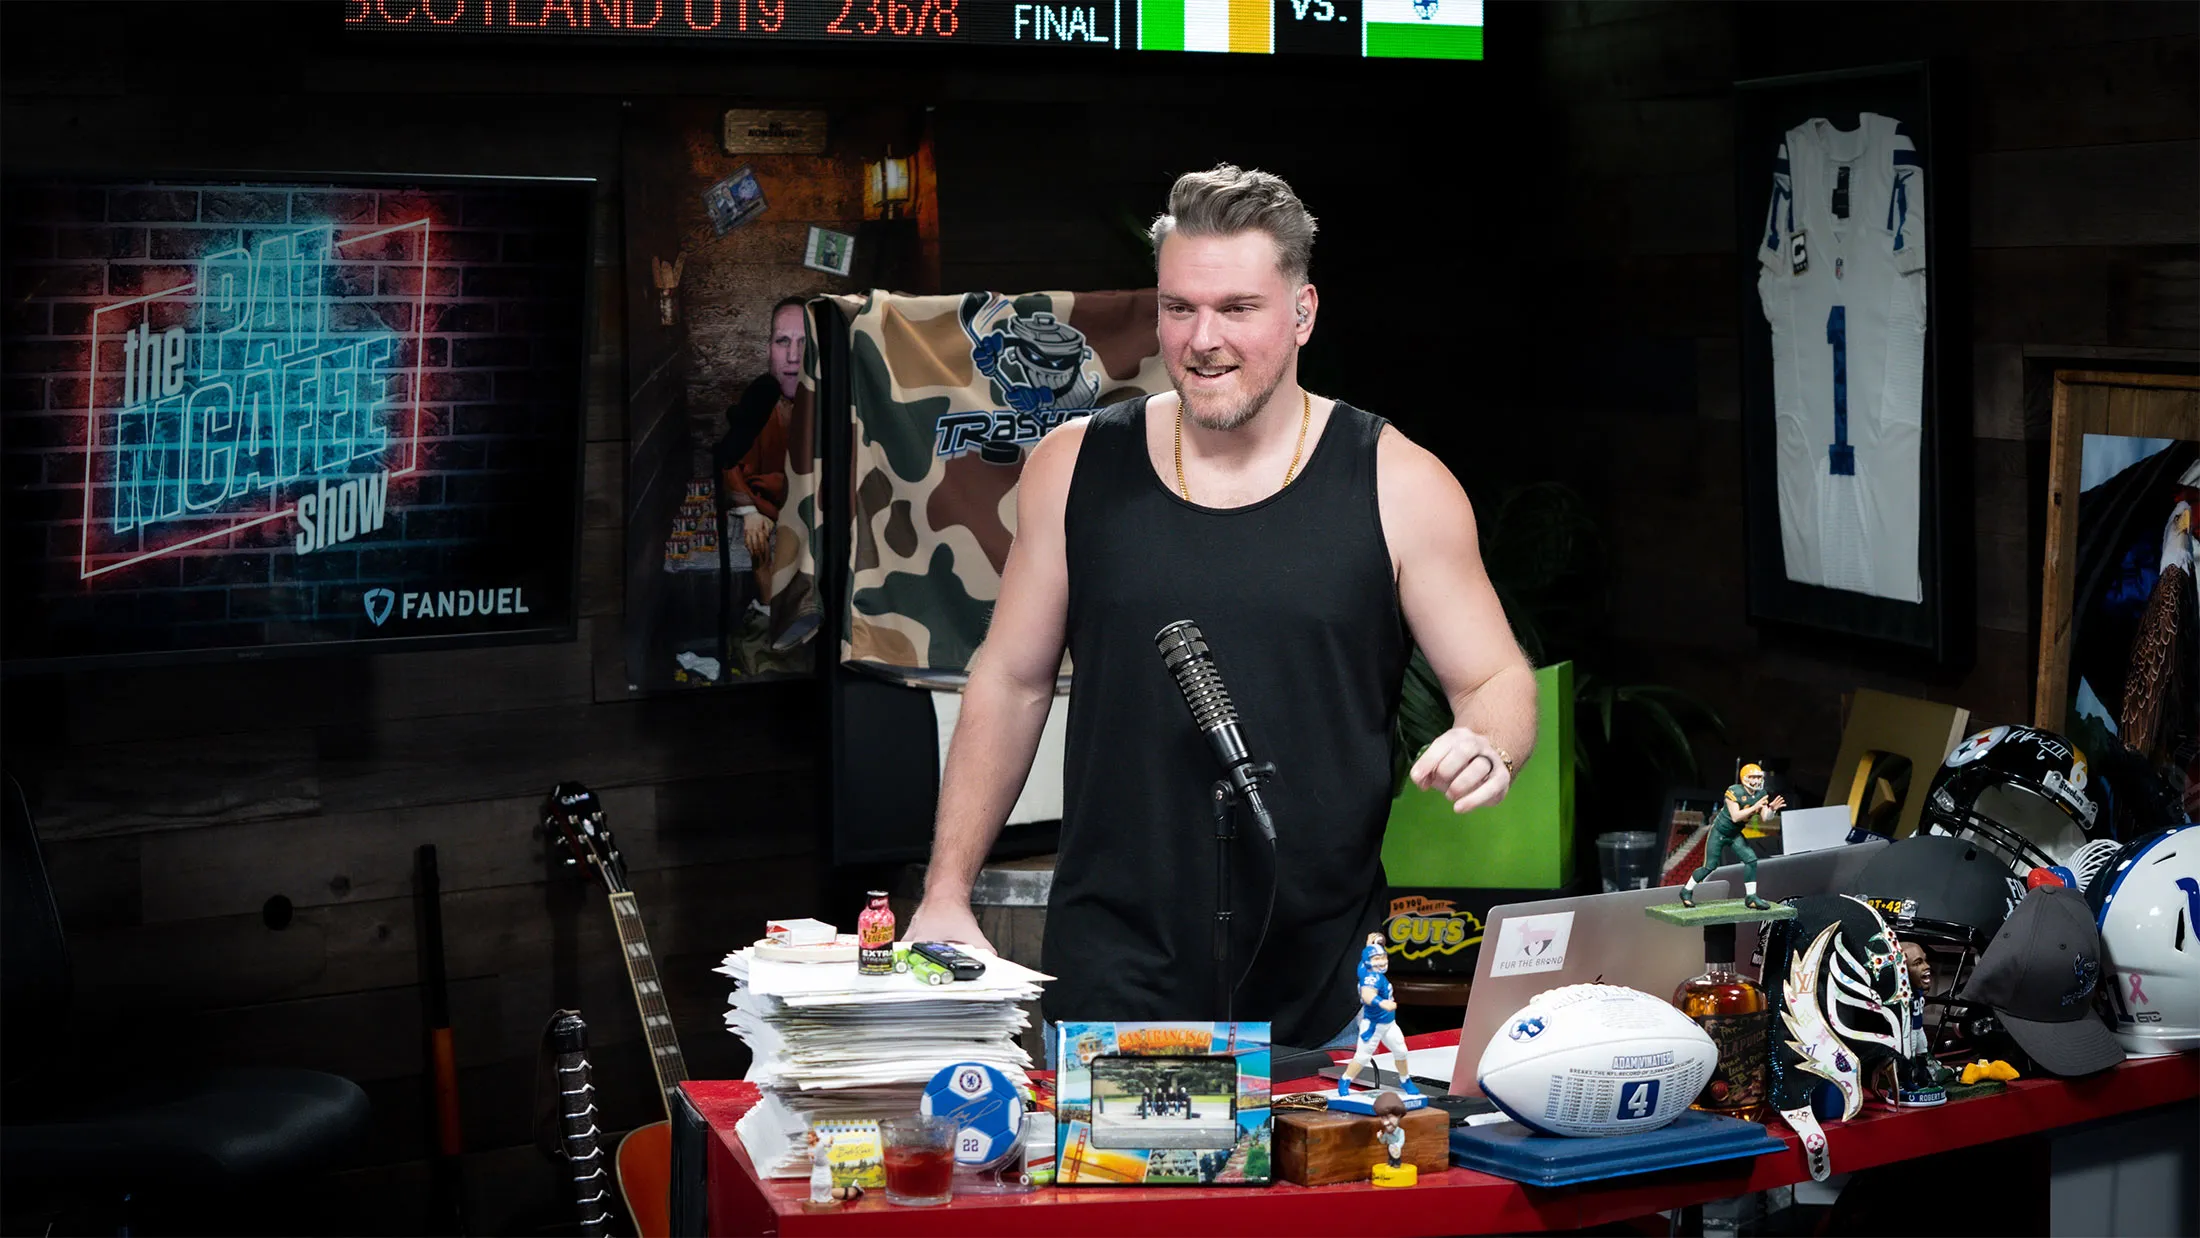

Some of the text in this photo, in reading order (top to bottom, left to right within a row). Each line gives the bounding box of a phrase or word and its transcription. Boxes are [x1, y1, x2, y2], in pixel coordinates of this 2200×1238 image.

[1014, 4, 1110, 43] FINAL
[199, 222, 335, 383] PAT
[123, 322, 187, 408] the
[1825, 304, 1856, 476] 1
[113, 334, 393, 535] MCAFEE
[295, 469, 390, 557] show
[401, 587, 530, 620] FANDUEL
[2069, 760, 2088, 792] 6
[2058, 779, 2085, 808] Steelers
[1406, 897, 1423, 908] YOU
[1389, 914, 1466, 945] GUTS
[1500, 960, 1516, 970] FUR
[1517, 958, 1534, 968] THE
[1145, 1028, 1213, 1048] FRANCISCO
[1613, 1055, 1639, 1070] ADAM
[1627, 1083, 1650, 1118] 4
[1919, 1090, 1941, 1102] ROBERT
[963, 1138, 979, 1152] 22
